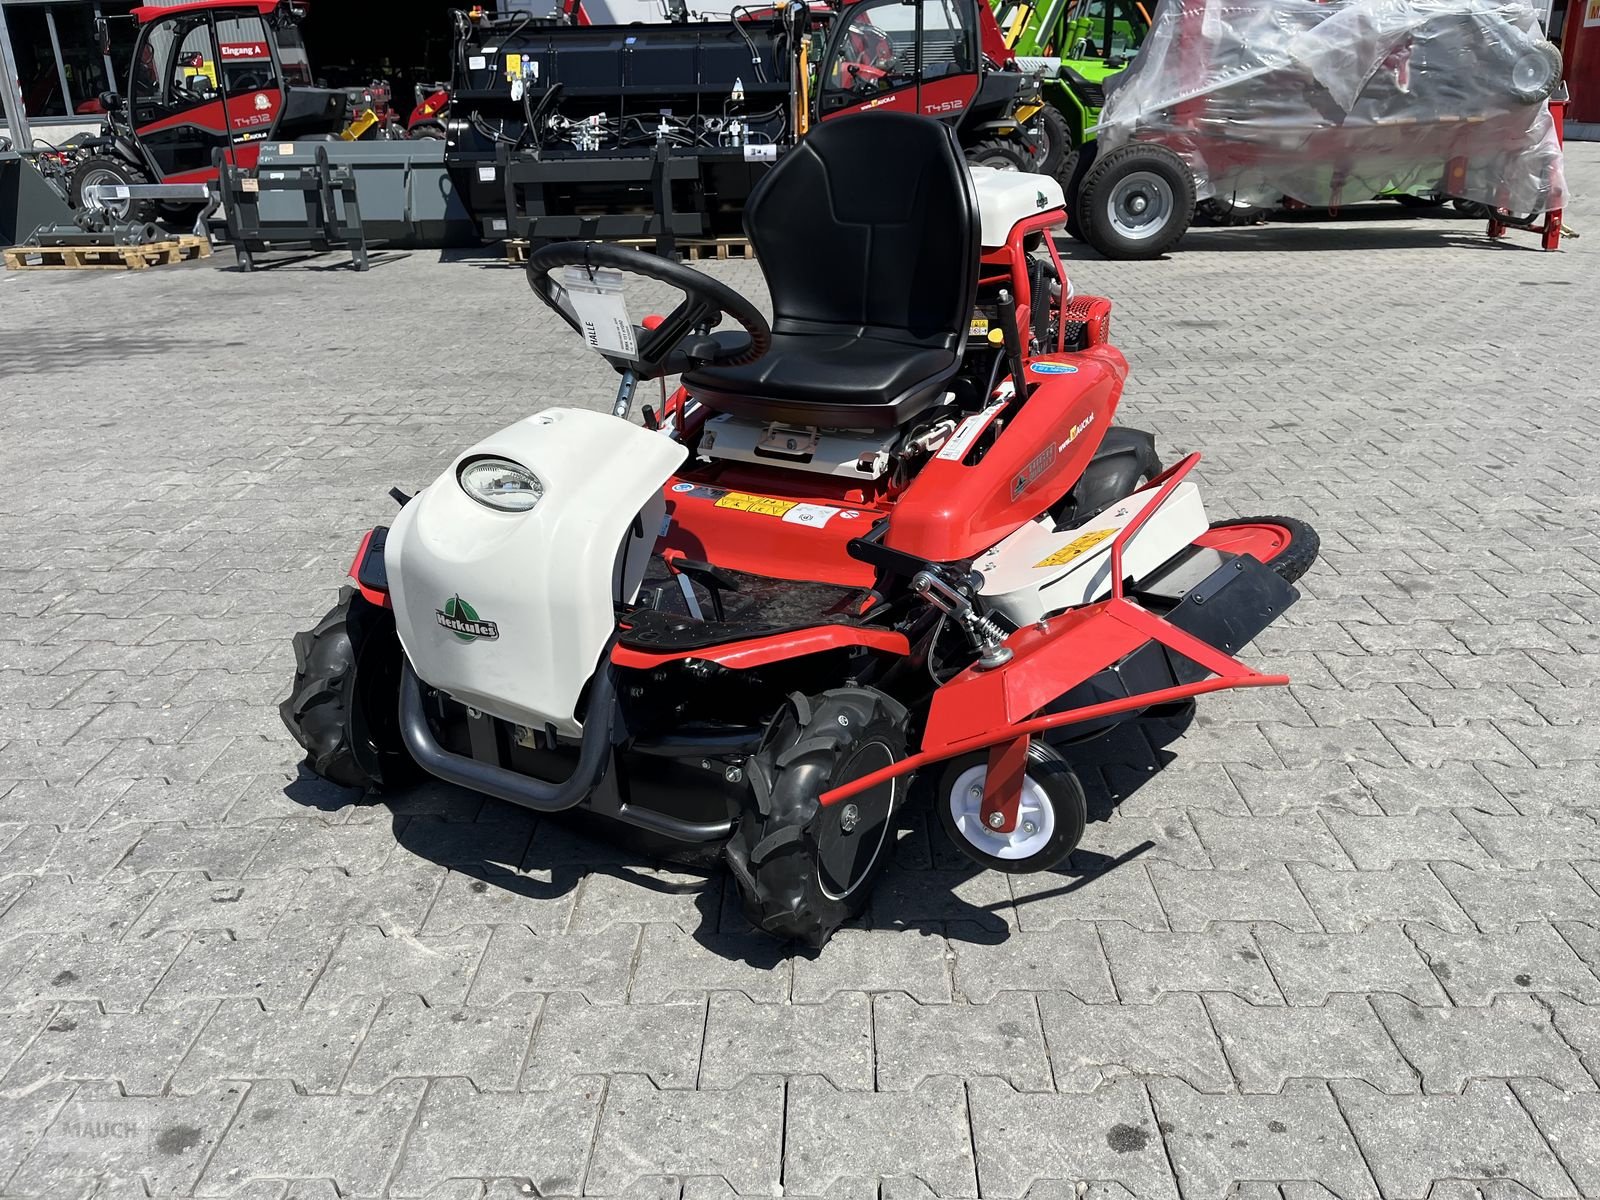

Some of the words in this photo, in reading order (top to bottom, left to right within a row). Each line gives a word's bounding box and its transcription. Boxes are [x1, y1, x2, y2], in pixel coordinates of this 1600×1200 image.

[222, 47, 254, 56] Eingang
[255, 46, 261, 54] A
[925, 100, 963, 113] T4512
[234, 113, 271, 127] T4512
[585, 321, 598, 346] HALLE
[436, 613, 496, 636] Herkules
